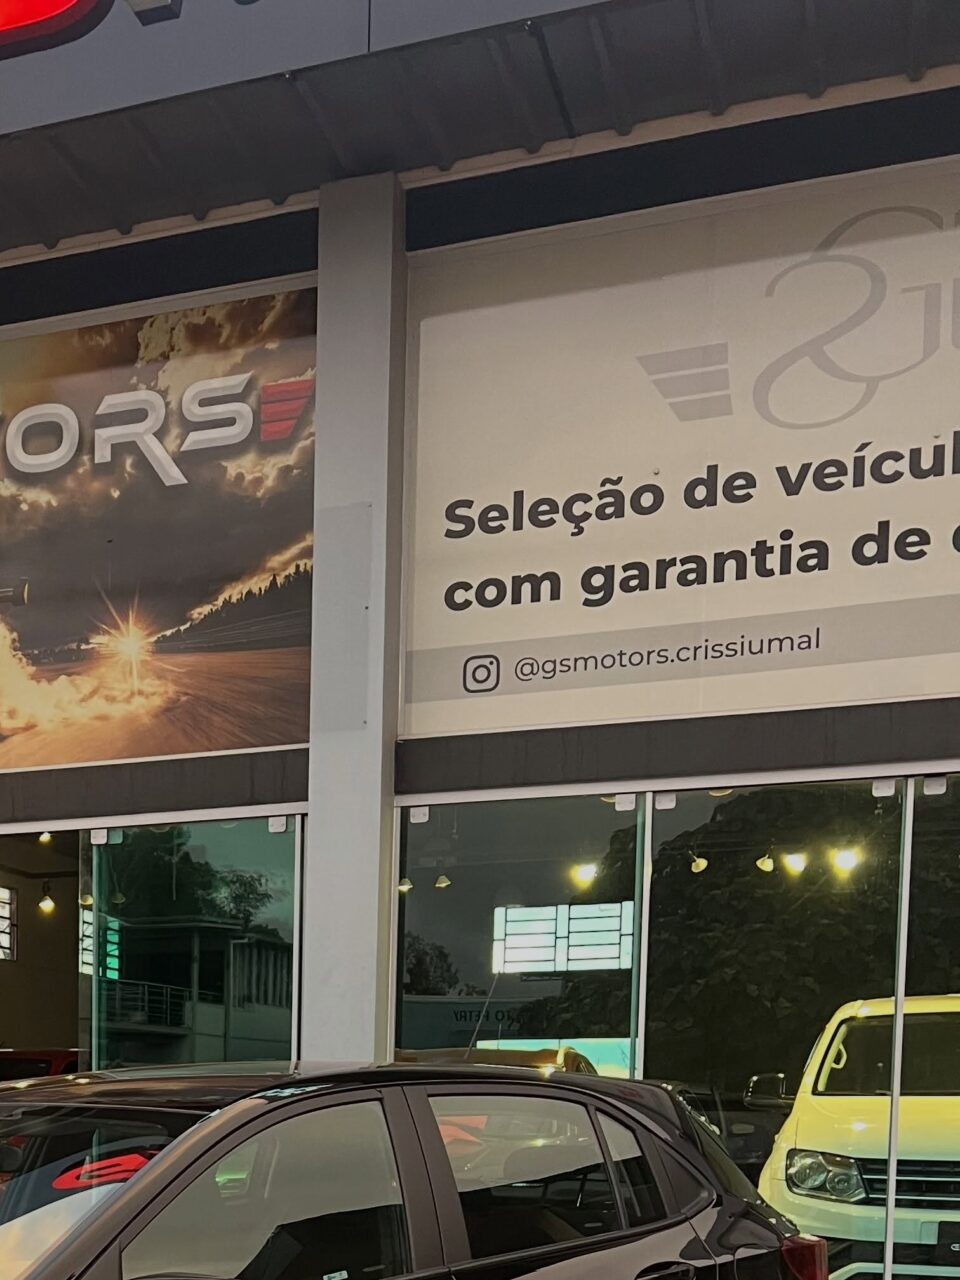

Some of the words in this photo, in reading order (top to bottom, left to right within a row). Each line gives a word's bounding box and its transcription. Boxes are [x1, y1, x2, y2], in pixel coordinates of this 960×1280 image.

[443, 476, 665, 539] Seleção
[683, 464, 757, 510] de
[443, 572, 562, 612] com
[580, 529, 830, 608] garantia
[851, 520, 931, 566] de
[514, 628, 821, 682] @gsmotors.crissiumal
